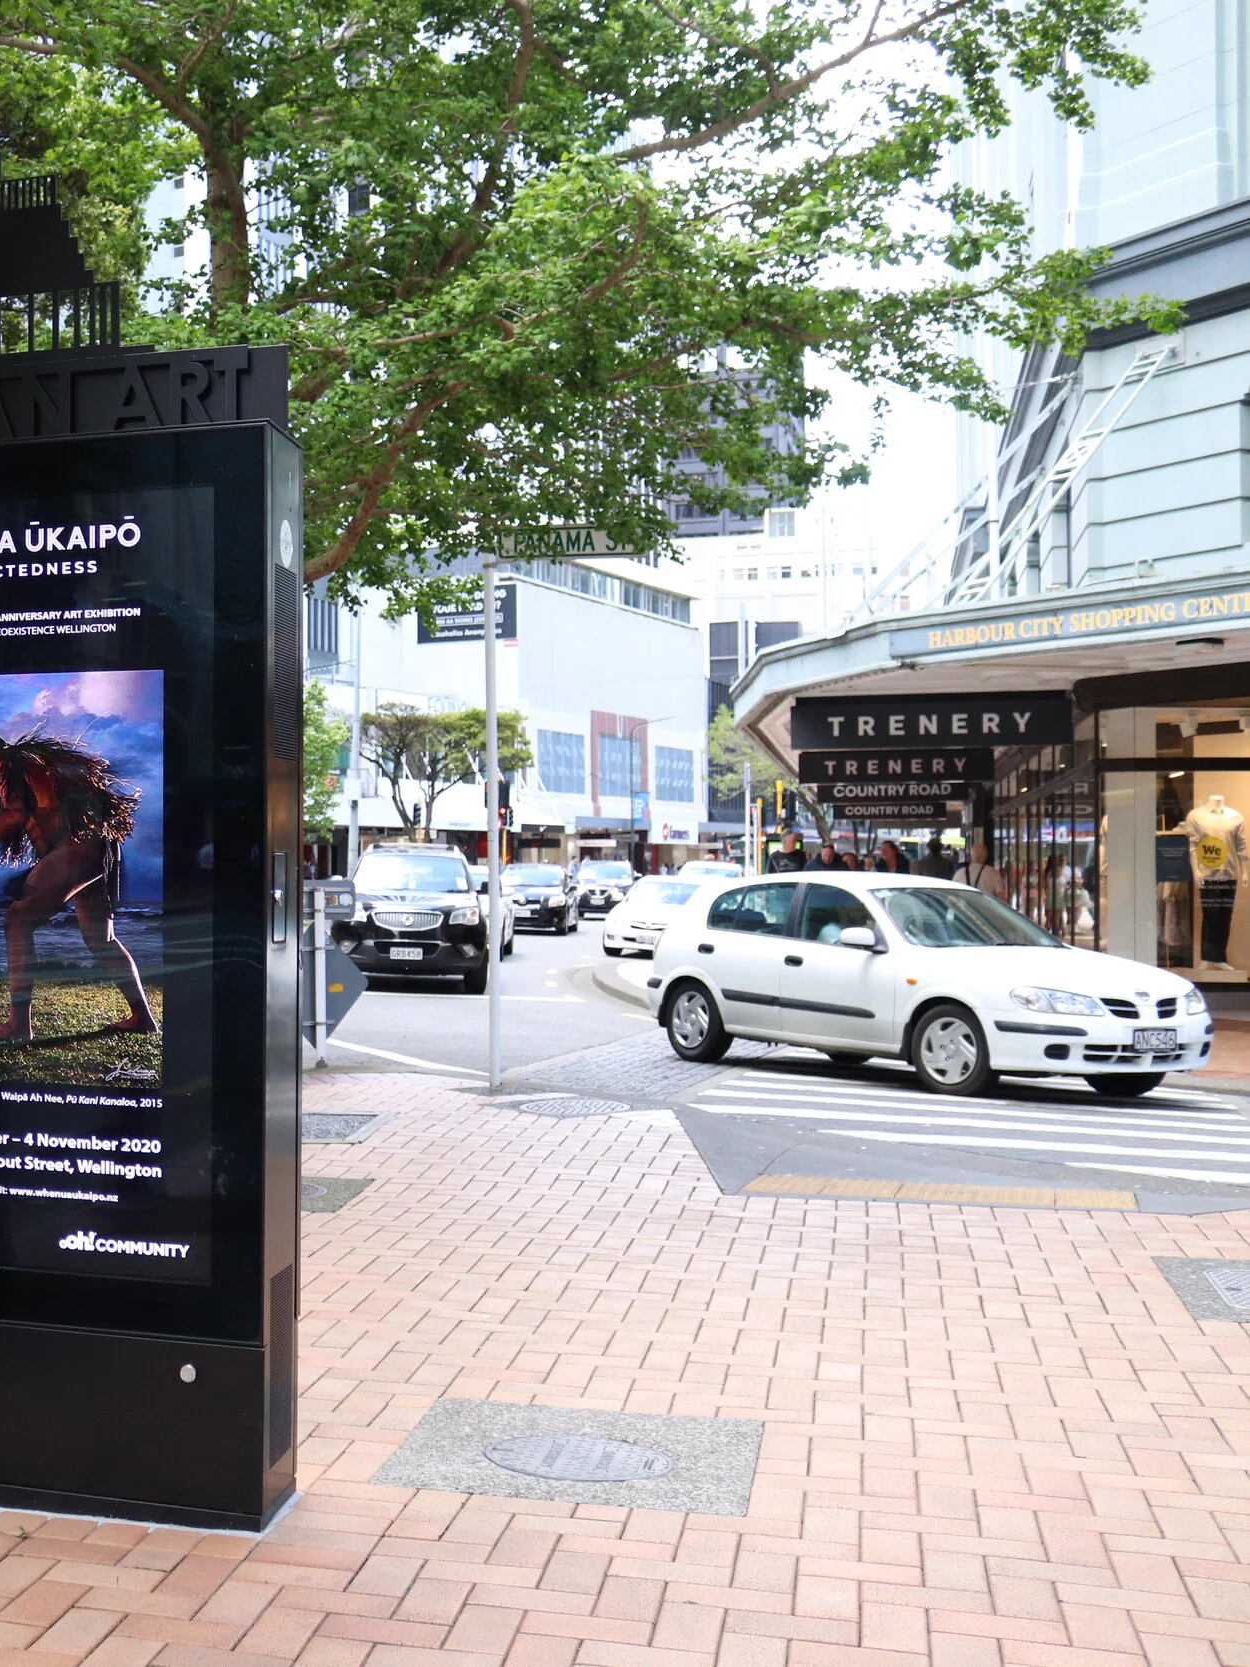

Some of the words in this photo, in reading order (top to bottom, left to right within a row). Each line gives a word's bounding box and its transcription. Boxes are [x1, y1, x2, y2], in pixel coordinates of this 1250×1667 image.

[115, 358, 248, 428] ART
[25, 515, 141, 553] ŪKAIPŌ
[514, 530, 595, 553] PANAMA
[63, 609, 83, 619] ART
[84, 607, 141, 619] EXHIBITION
[56, 623, 116, 635] WELLINGTON
[928, 622, 1017, 649] HARBOUR
[1019, 616, 1065, 638] CITY
[1069, 602, 1176, 633] SHOPPING
[828, 712, 1032, 737] TRENERY
[824, 758, 966, 776] TRENERY
[833, 784, 906, 798] COUNTRY
[909, 783, 952, 797] ROAD
[845, 806, 899, 816] COUNTRY
[902, 805, 934, 815] ROAD
[1202, 845, 1222, 856] We
[1135, 1031, 1175, 1047] ANC546
[30, 1092, 42, 1102] Ah
[44, 1093, 65, 1104] Nee,
[78, 1095, 98, 1105] Kani
[99, 1096, 138, 1108] Kanaloa,
[140, 1098, 163, 1108] 2015
[23, 1133, 34, 1147] 4
[37, 1133, 118, 1152] November
[121, 1138, 162, 1154] 2020
[24, 1156, 74, 1175] Street,
[77, 1159, 163, 1180] Wellington
[9, 1186, 119, 1202] www.whenuaukaipo.nz
[95, 1239, 190, 1258] COMMUNITY
